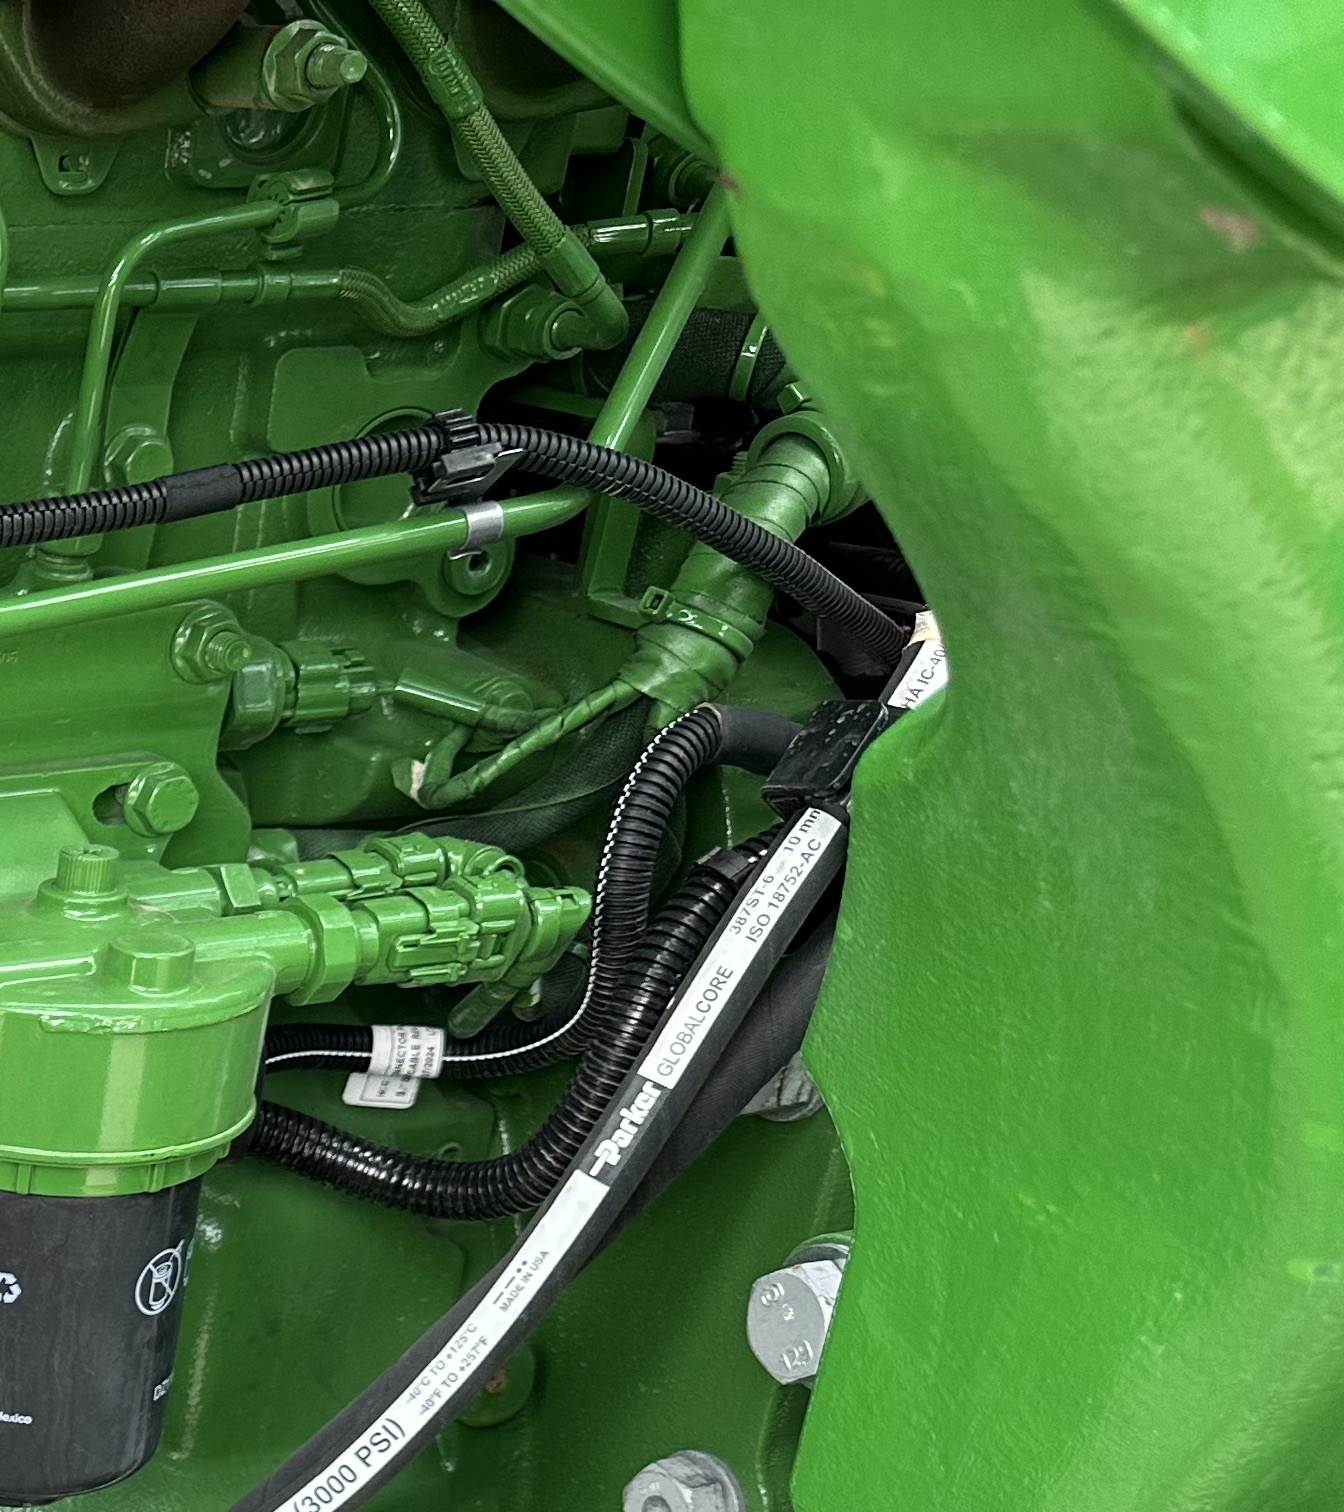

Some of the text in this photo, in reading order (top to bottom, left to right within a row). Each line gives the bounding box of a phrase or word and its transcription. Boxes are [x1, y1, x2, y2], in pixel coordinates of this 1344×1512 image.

[900, 687, 925, 708] HA
[916, 643, 946, 686] IC-40
[728, 874, 775, 935] 387ST-6
[783, 835, 802, 853] 10
[744, 837, 822, 943] ISO 18752-AC
[656, 964, 735, 1078] GLOBALCORE
[588, 1080, 662, 1177] Parker
[498, 1249, 550, 1313] MADE IN USA
[428, 1359, 447, 1377] TO
[440, 1371, 459, 1390] TO
[353, 1417, 407, 1469] PSI)
